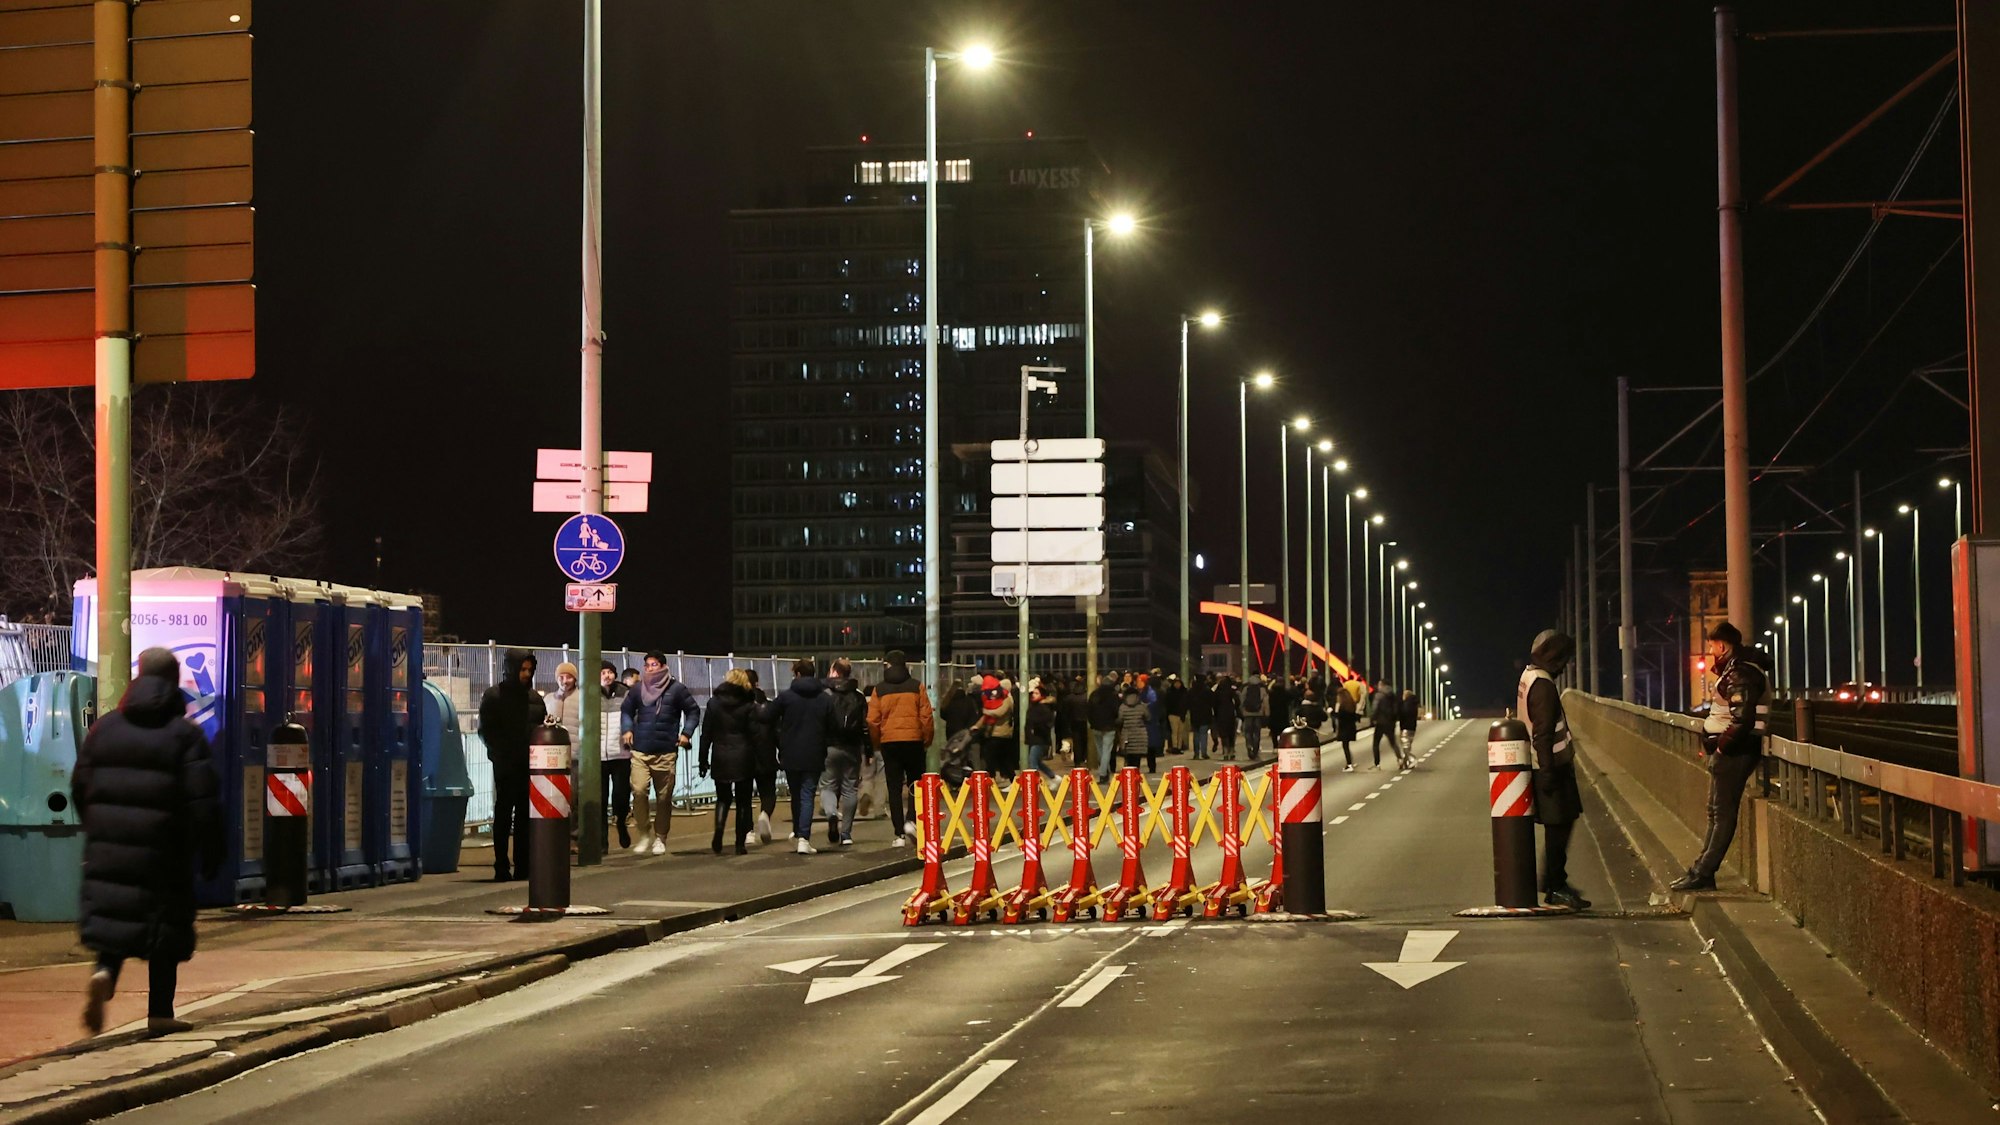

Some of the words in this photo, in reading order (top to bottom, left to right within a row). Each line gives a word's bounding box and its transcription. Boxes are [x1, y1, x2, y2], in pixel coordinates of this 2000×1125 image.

[1009, 167, 1080, 189] LANXESS
[169, 614, 189, 626] 981
[193, 614, 207, 626] 00
